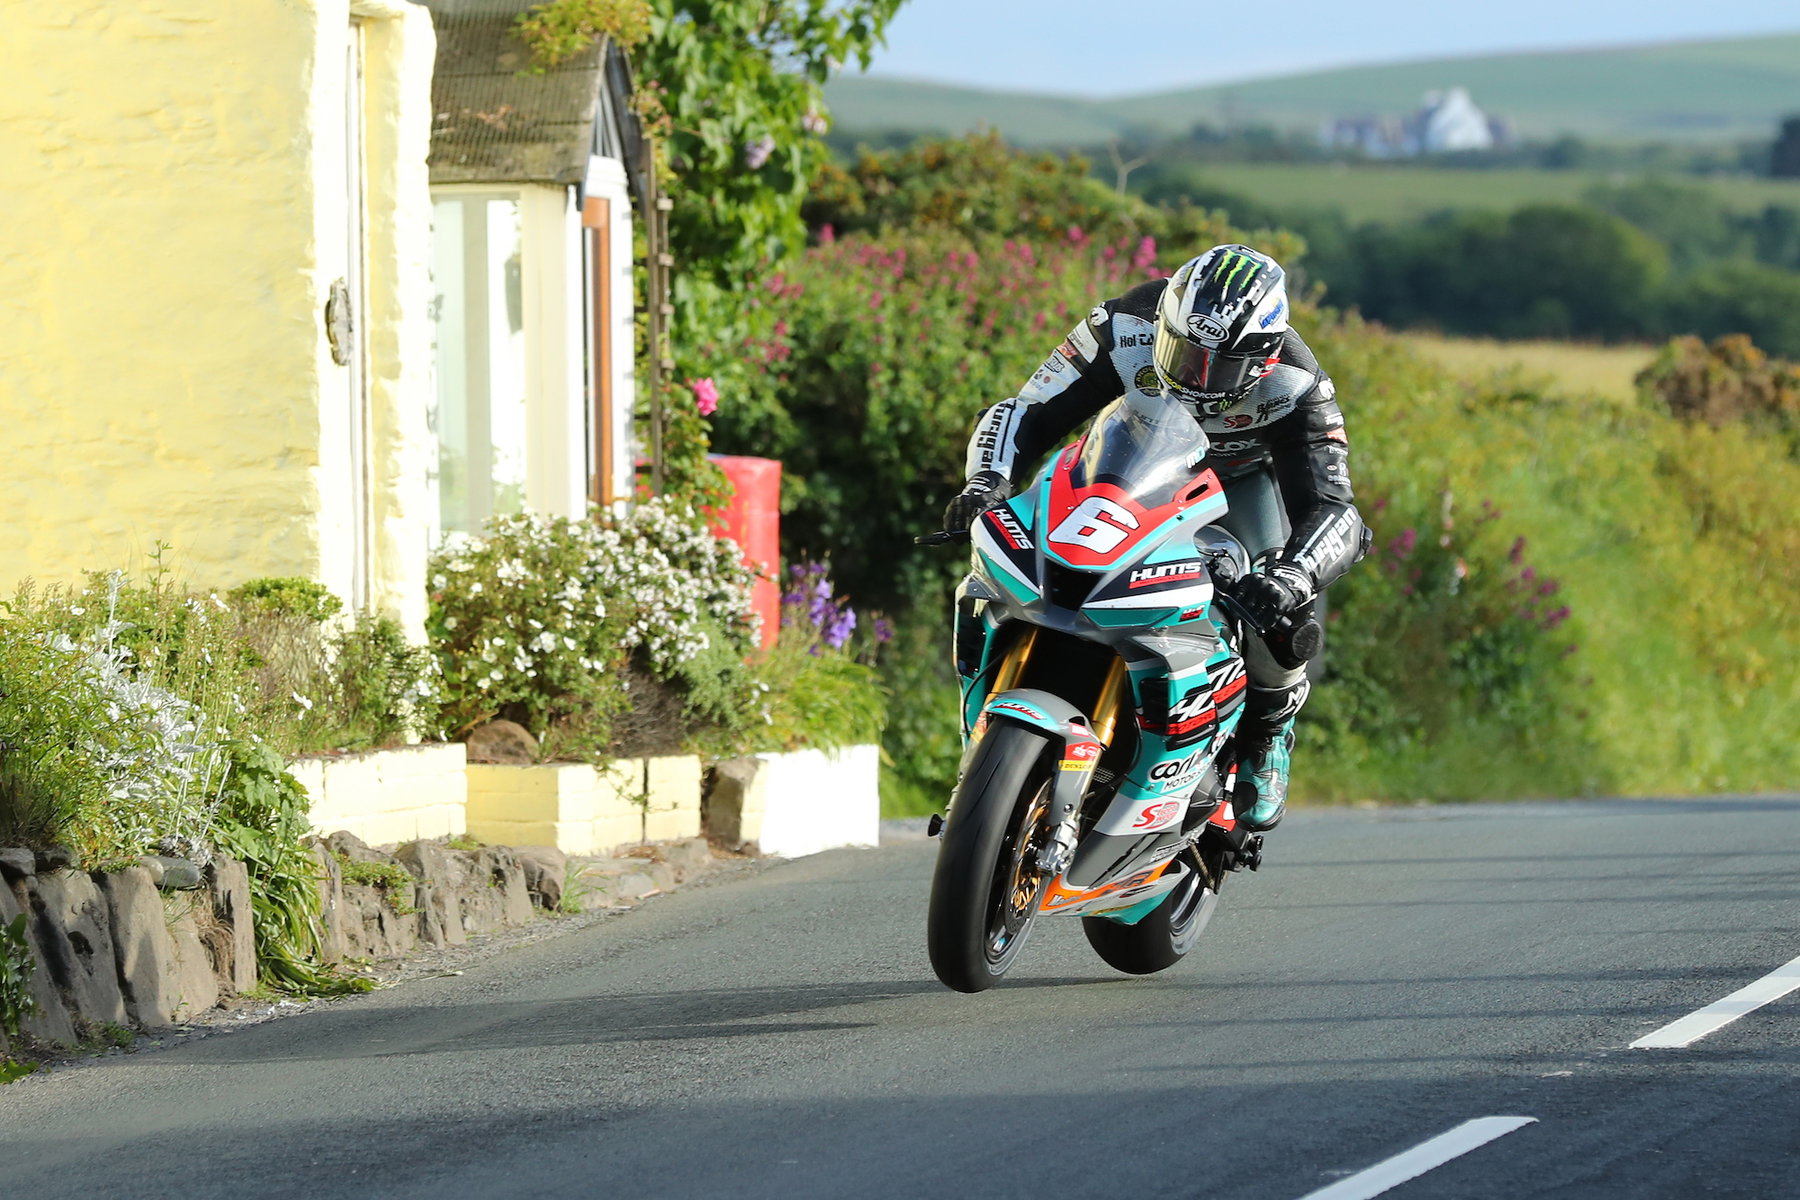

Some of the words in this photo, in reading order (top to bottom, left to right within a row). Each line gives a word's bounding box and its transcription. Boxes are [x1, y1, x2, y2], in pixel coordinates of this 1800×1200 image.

[1188, 315, 1223, 338] Arai
[1047, 495, 1140, 555] 6
[1129, 561, 1201, 583] HUNTS
